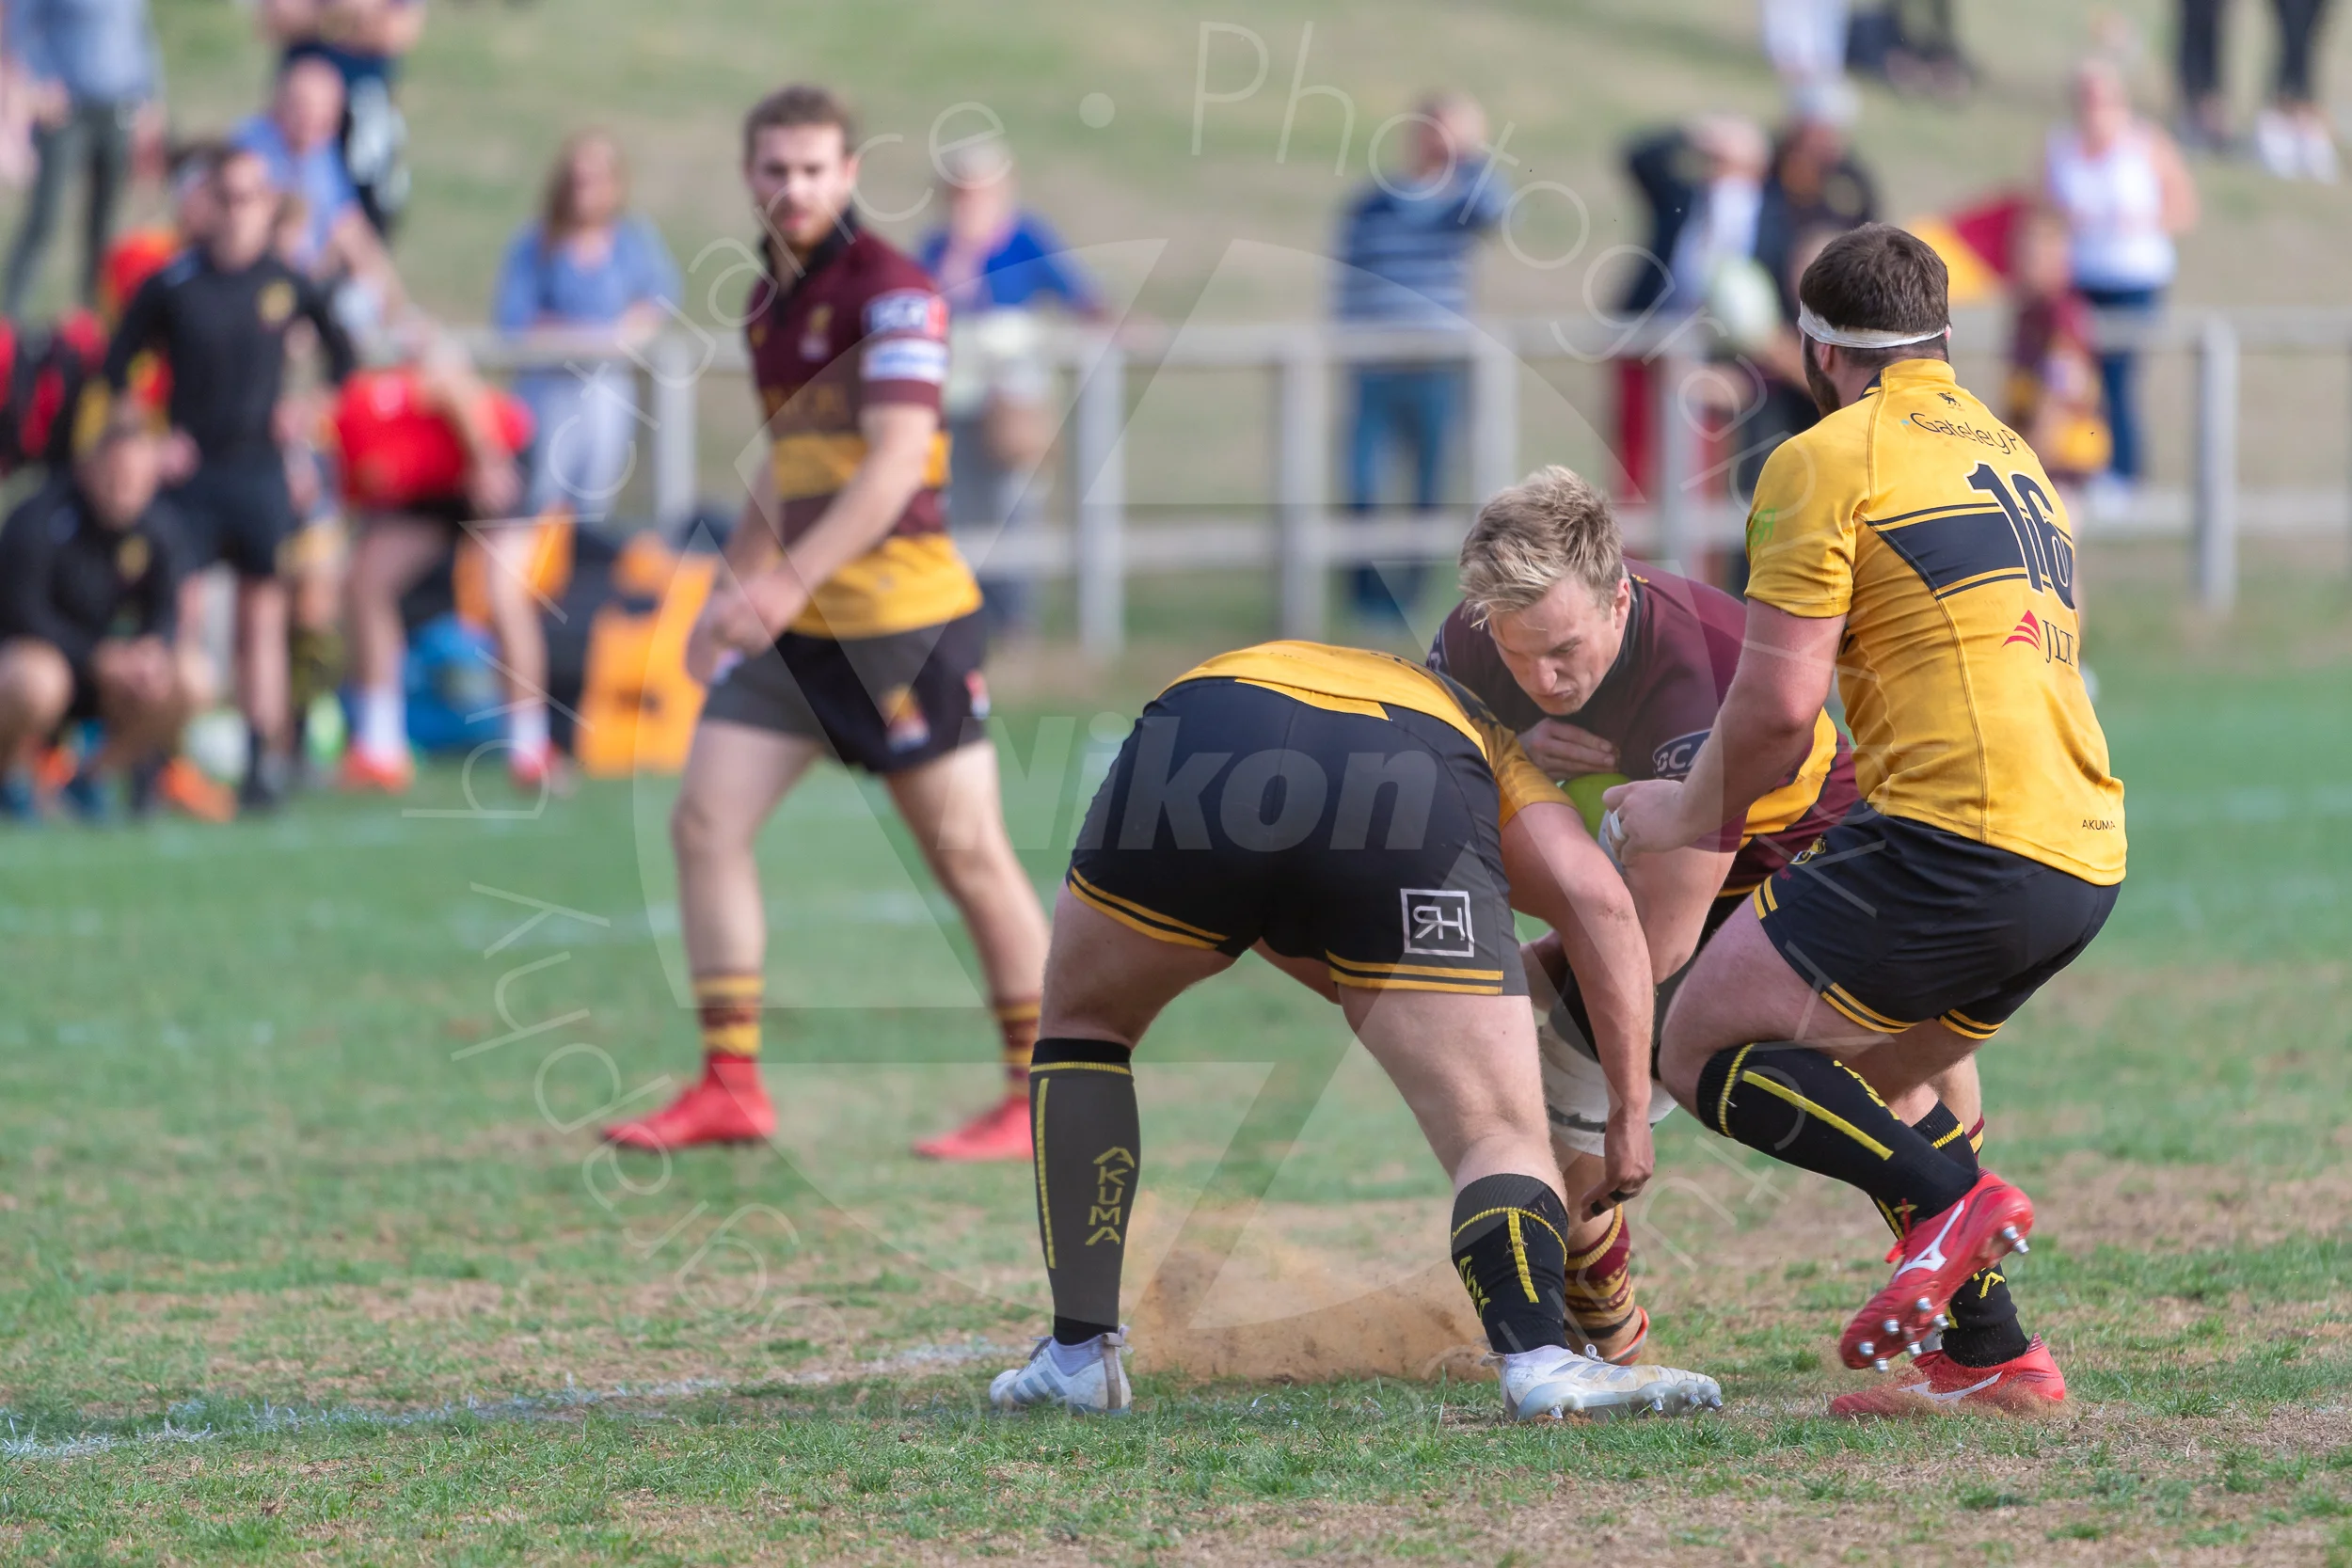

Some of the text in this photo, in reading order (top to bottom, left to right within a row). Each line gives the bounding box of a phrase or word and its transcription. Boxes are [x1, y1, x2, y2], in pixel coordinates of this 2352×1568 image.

[1964, 459, 2076, 611] 16
[2042, 619, 2074, 667] JLT
[2081, 818, 2117, 832] AKUMA
[1085, 1146, 1135, 1246] AKUMA
